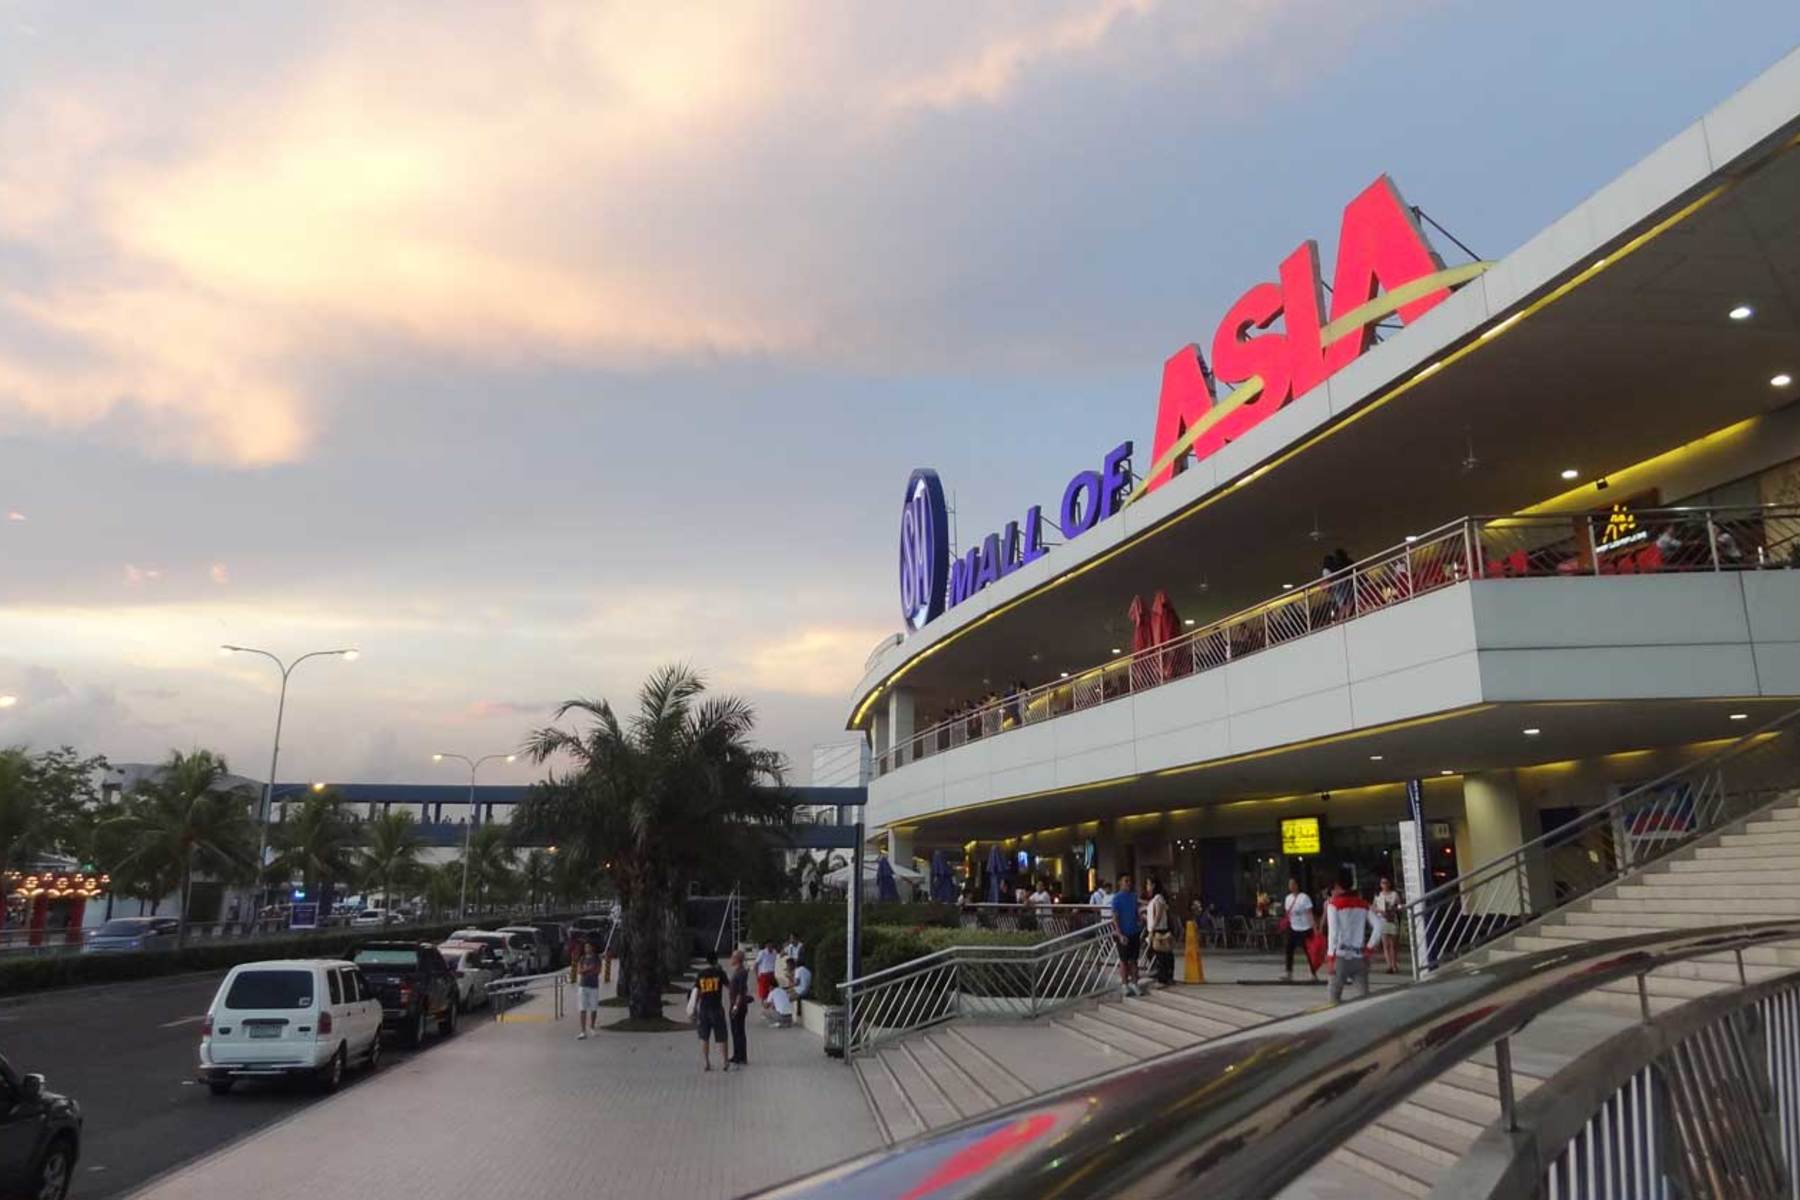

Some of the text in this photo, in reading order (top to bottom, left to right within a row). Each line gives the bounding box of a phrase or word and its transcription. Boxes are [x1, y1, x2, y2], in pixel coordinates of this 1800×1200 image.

[948, 172, 1452, 609] MALL OF ASIA
[901, 491, 931, 618] SM
